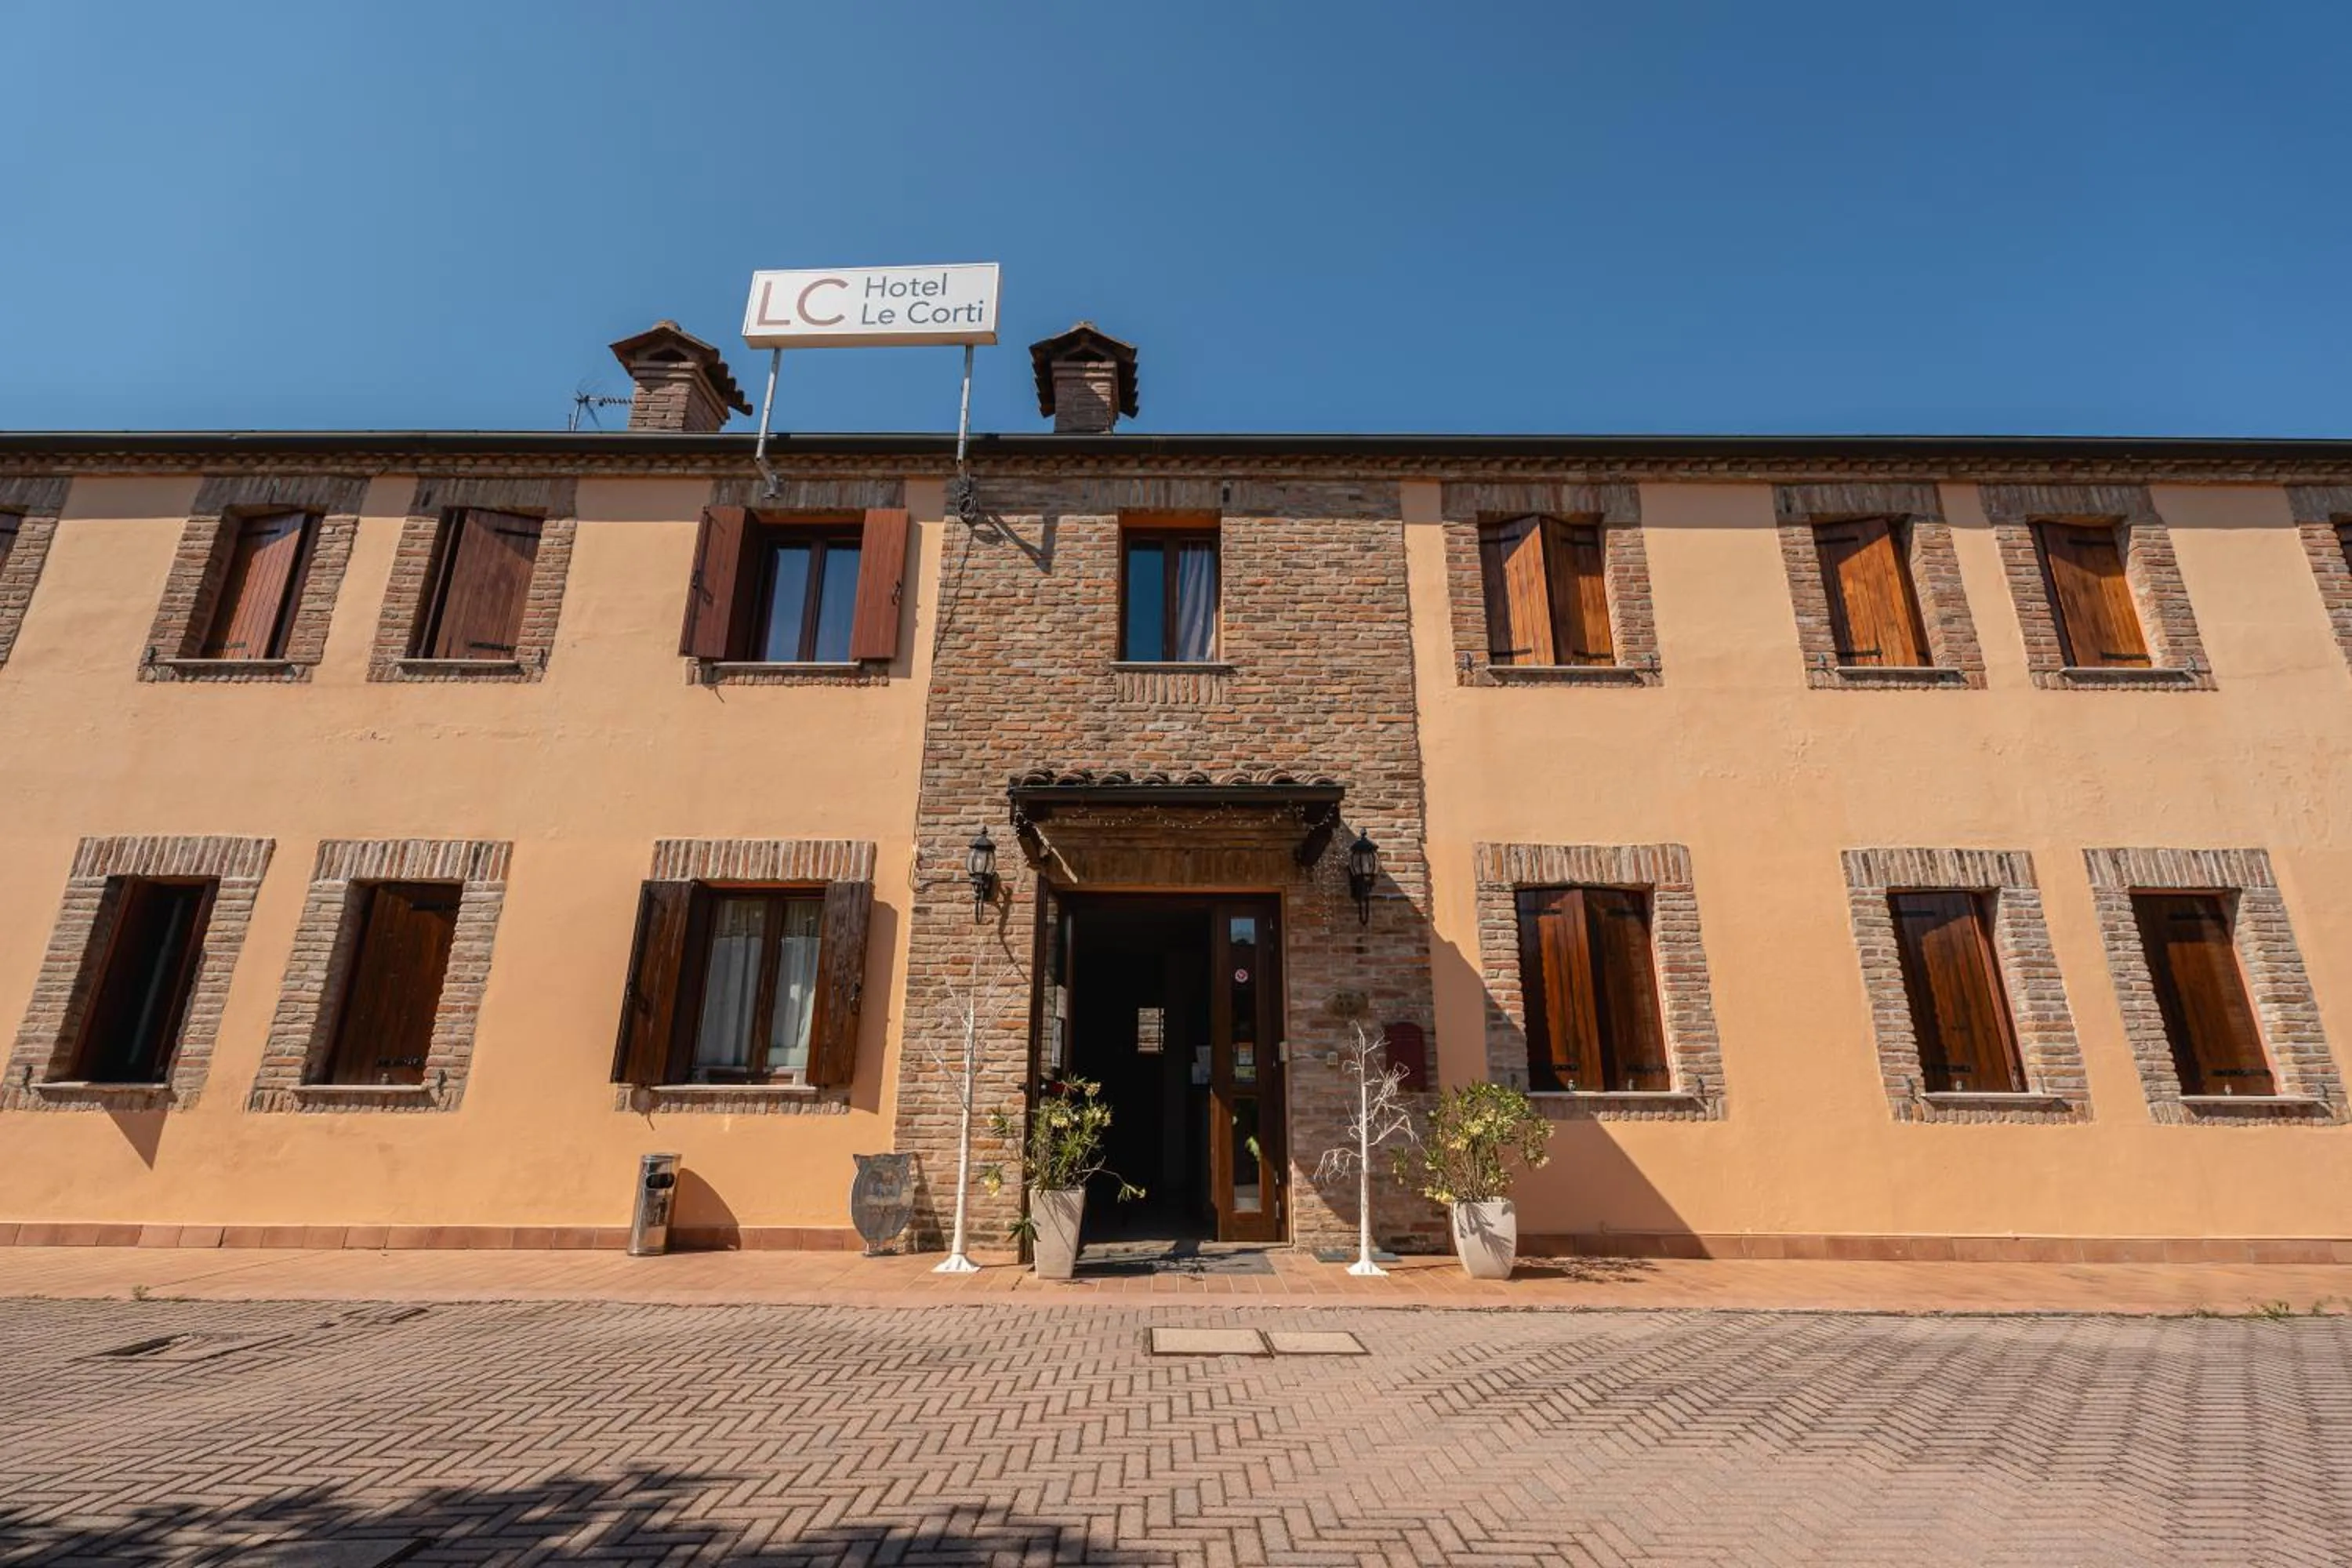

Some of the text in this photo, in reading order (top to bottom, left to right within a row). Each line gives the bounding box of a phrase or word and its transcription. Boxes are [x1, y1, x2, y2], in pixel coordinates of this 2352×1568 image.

[865, 272, 948, 298] Hotel
[757, 278, 850, 327] LC
[862, 300, 985, 325] Le Corti
